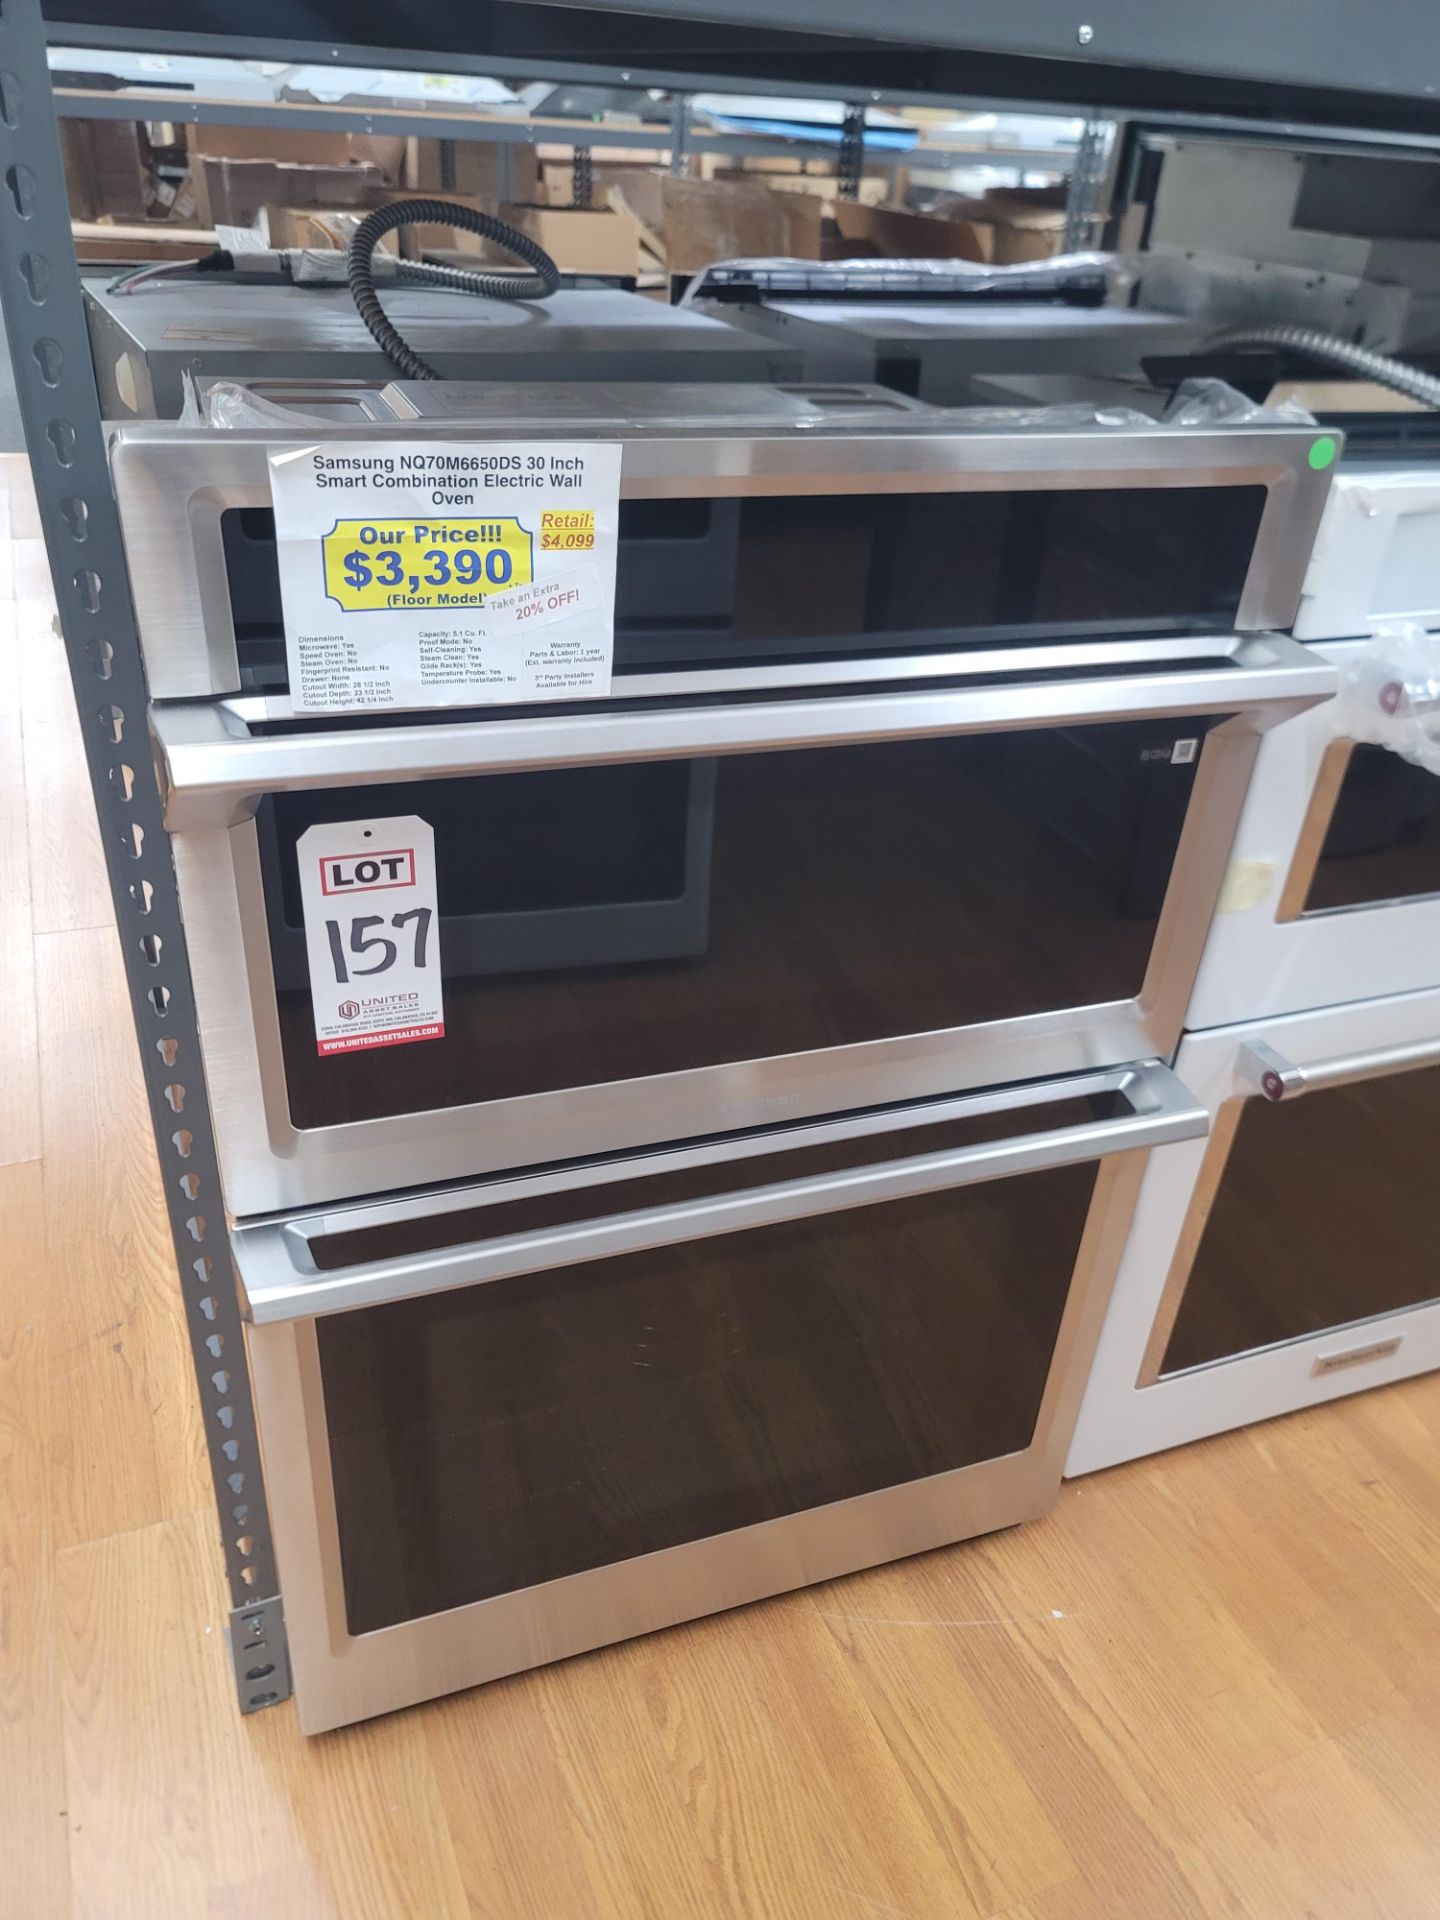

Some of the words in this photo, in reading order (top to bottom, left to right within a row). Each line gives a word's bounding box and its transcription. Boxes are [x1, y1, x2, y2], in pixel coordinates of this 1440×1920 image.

[313, 455, 394, 472] Samsung
[401, 456, 521, 470] NQ70M6650DS
[527, 456, 545, 470] 30
[550, 456, 584, 470] Inch
[316, 474, 367, 488] Smart
[372, 474, 478, 488] Combination
[484, 474, 544, 488] Electric
[549, 474, 582, 487] Wall
[431, 491, 474, 505] Oven
[541, 513, 595, 528] Retail:
[360, 526, 405, 544] Our
[414, 525, 501, 543] Price!!!
[541, 534, 595, 549] $4,099
[344, 549, 513, 594] $3,390
[387, 594, 434, 608] (Floor
[490, 600, 515, 611] Take
[518, 593, 530, 603] an
[533, 583, 560, 598] Extra
[515, 601, 544, 620] 20%
[547, 589, 580, 610] OFF!
[298, 635, 344, 643] Dimensions
[299, 643, 340, 651] Microwave:
[419, 646, 467, 654] Self-Cleaning:
[556, 649, 578, 657] Labor:
[300, 652, 322, 660] Speed
[301, 667, 340, 675] Fingerprint
[342, 665, 378, 673] Resistant:
[421, 670, 463, 678] Temperature
[421, 677, 467, 685] Undercounter
[303, 691, 327, 699] Cutout
[332, 857, 404, 887] LOT
[325, 907, 432, 983] 157
[361, 992, 419, 1007] UNITED
[322, 1026, 439, 1051] WWW.UNITEDASSETSALES.COM
